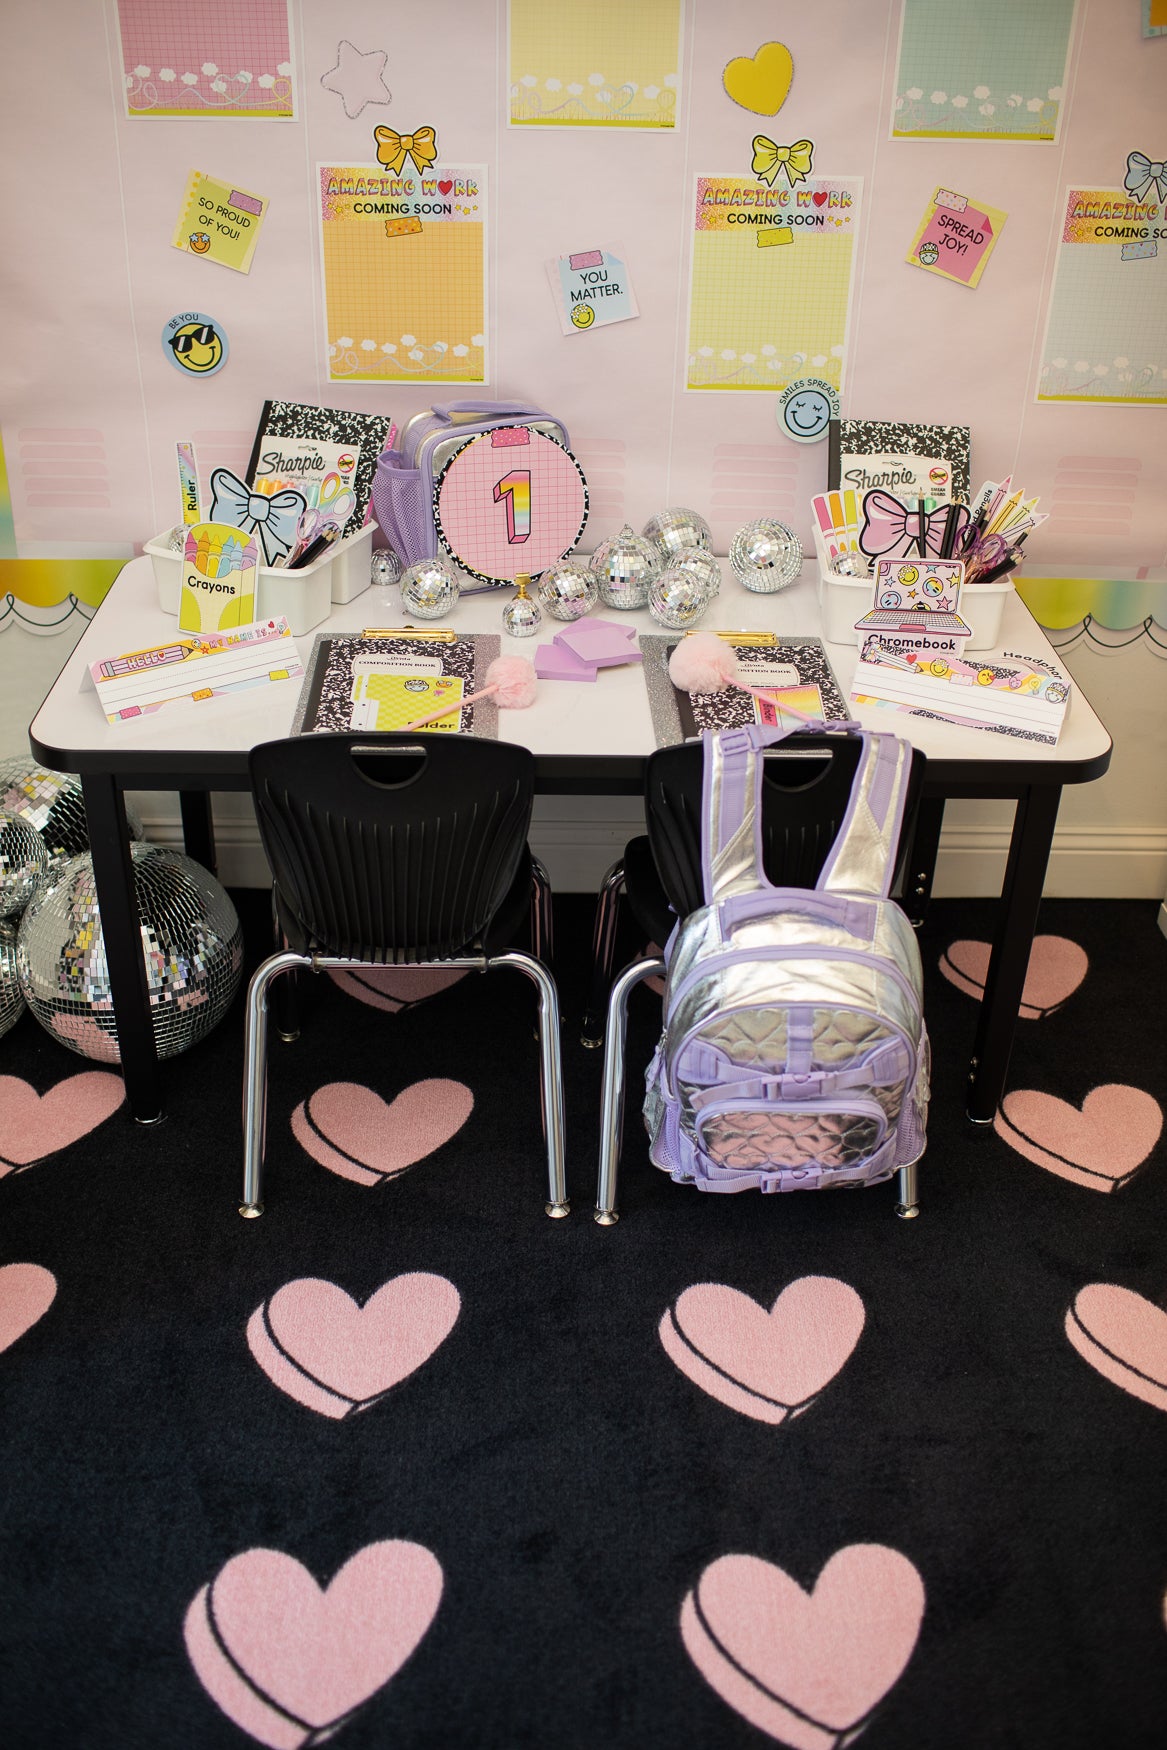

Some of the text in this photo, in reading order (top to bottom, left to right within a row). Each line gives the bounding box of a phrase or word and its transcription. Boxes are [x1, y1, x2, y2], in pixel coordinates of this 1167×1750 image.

[326, 177, 416, 197] AMAZING
[701, 187, 791, 208] AMAZING
[198, 197, 251, 228] SO PROUD
[353, 203, 452, 215] COMING SOON
[1070, 201, 1159, 221] AMAZING
[198, 215, 241, 241] OF YOU!
[727, 213, 824, 226] COMING SOON
[937, 214, 985, 245] SPREAD
[1094, 226, 1167, 239] COMING SO
[938, 233, 969, 256] JOY!
[579, 269, 609, 285] YOU
[570, 283, 624, 302] MATTER.
[168, 313, 199, 330] BE YOU
[780, 378, 840, 417] SMILES SPREAD JOY
[256, 451, 326, 475] Sharpie
[844, 467, 917, 490] Sharpie
[186, 479, 198, 511] Ruler
[492, 469, 532, 545] 1
[187, 575, 236, 595] Crayons
[208, 638, 224, 650] MY
[226, 630, 254, 646] NAME
[867, 634, 956, 651] Chromebook
[126, 650, 166, 670] HELLO
